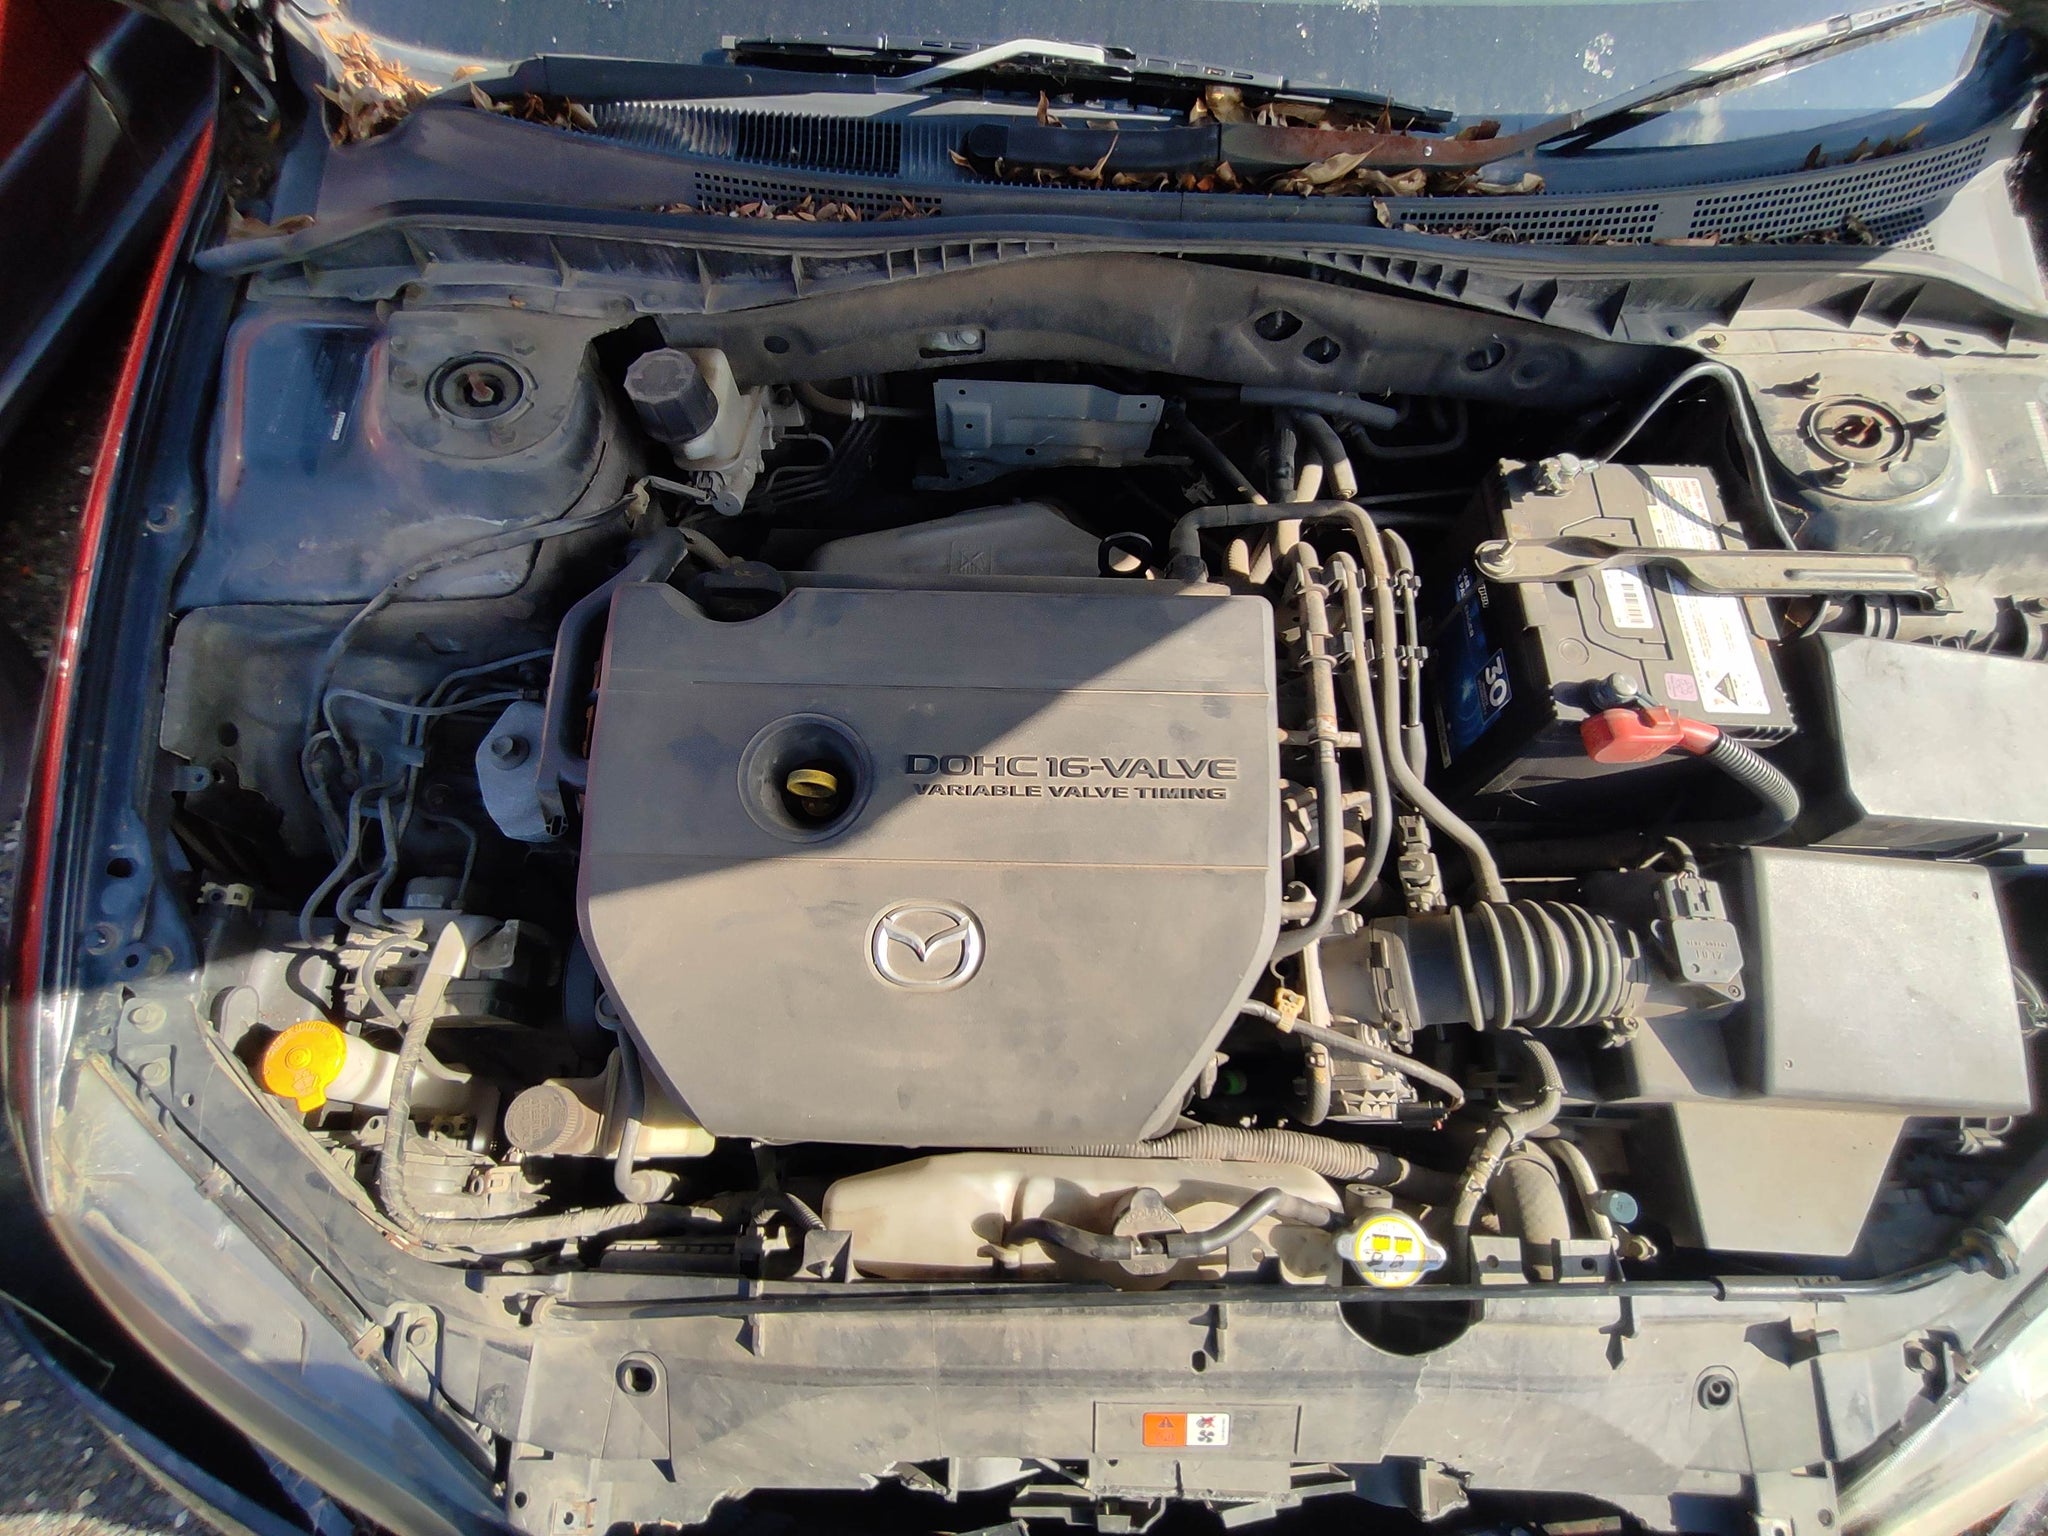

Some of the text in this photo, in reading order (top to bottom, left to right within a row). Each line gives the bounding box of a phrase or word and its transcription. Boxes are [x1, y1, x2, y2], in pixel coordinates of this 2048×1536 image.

[1485, 655, 1508, 708] 30
[904, 753, 1239, 781] DOHC 16-VALVE
[912, 782, 1227, 801] VARIABLE VALVE TIMING
